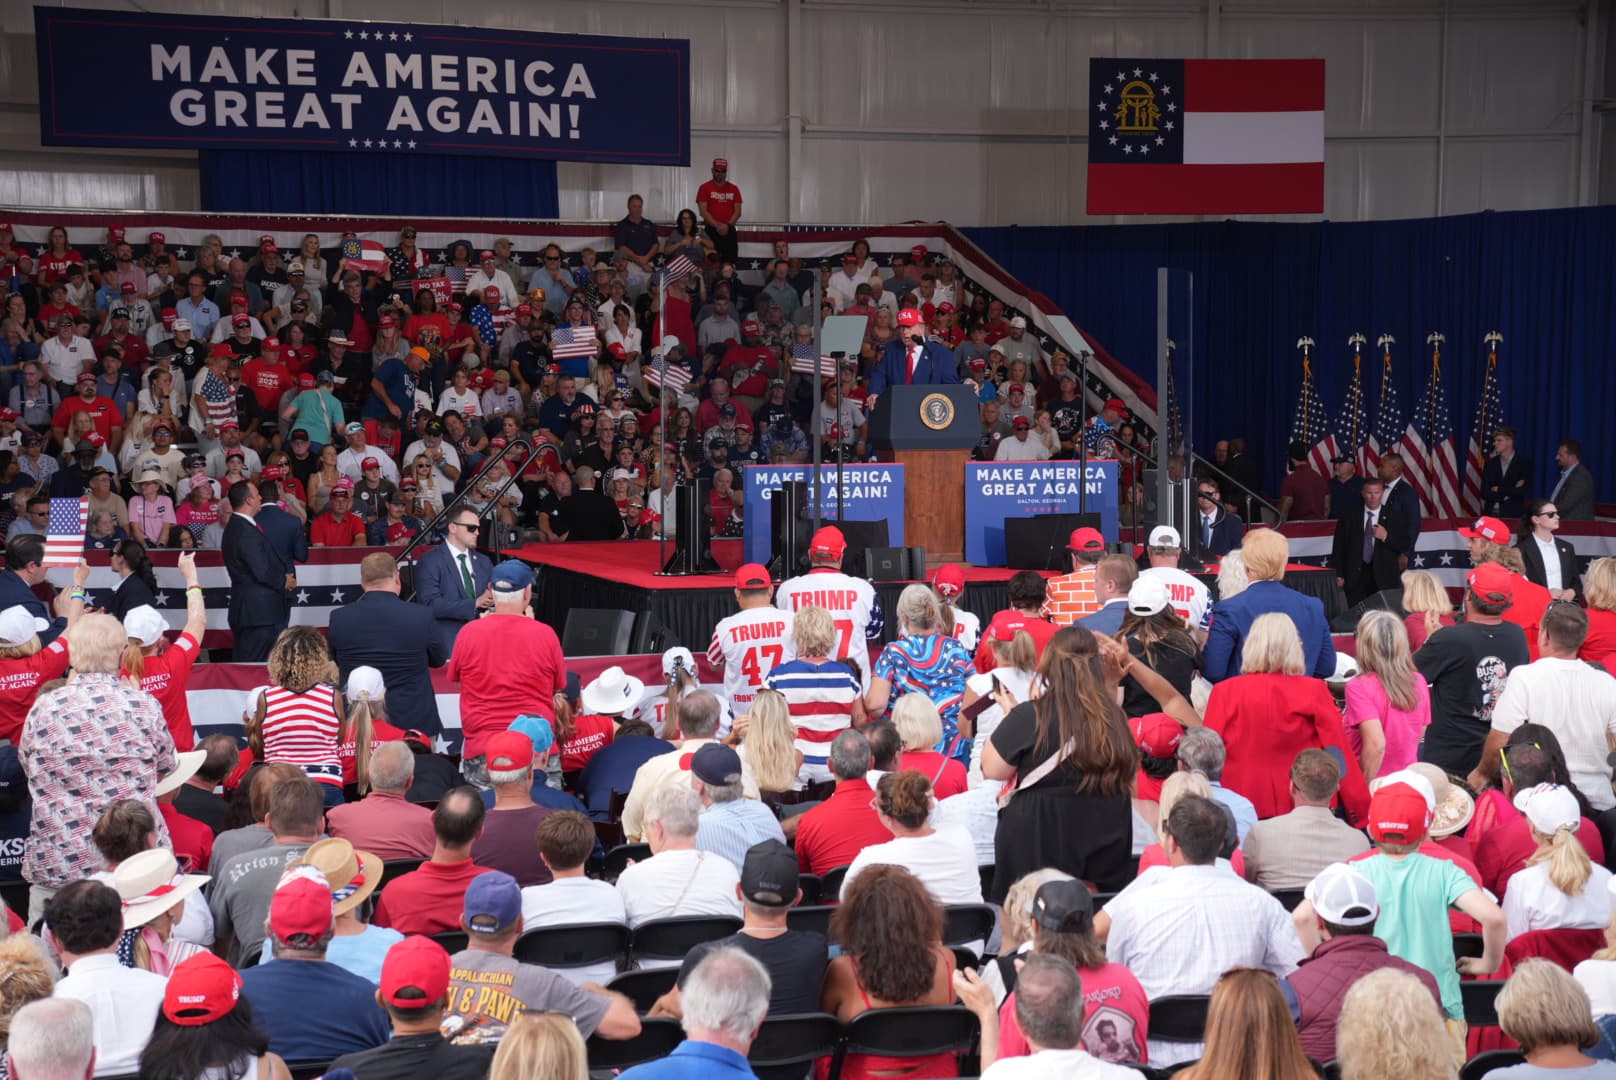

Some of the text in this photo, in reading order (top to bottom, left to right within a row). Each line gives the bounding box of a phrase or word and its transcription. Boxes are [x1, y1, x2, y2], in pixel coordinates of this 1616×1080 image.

[150, 43, 597, 100] MAKE AMERICA
[169, 89, 581, 140] GREAT AGAIN!
[419, 281, 445, 290] NO TAX
[755, 471, 804, 485] MAKE
[976, 467, 1106, 481] MAKE AMERICA
[827, 485, 888, 499] AGAIN!
[982, 482, 1103, 496] GREAT AGAN!
[790, 590, 858, 612] TRUMP
[729, 621, 786, 643] TRUMP
[741, 644, 784, 686] 47
[9, 679, 37, 690] AGAIN
[141, 672, 171, 685] ERICA
[575, 732, 606, 747] AMERICA
[581, 740, 604, 753] AGAIN
[449, 967, 515, 986] APPALACHIAN
[178, 994, 206, 1003] TRUMP
